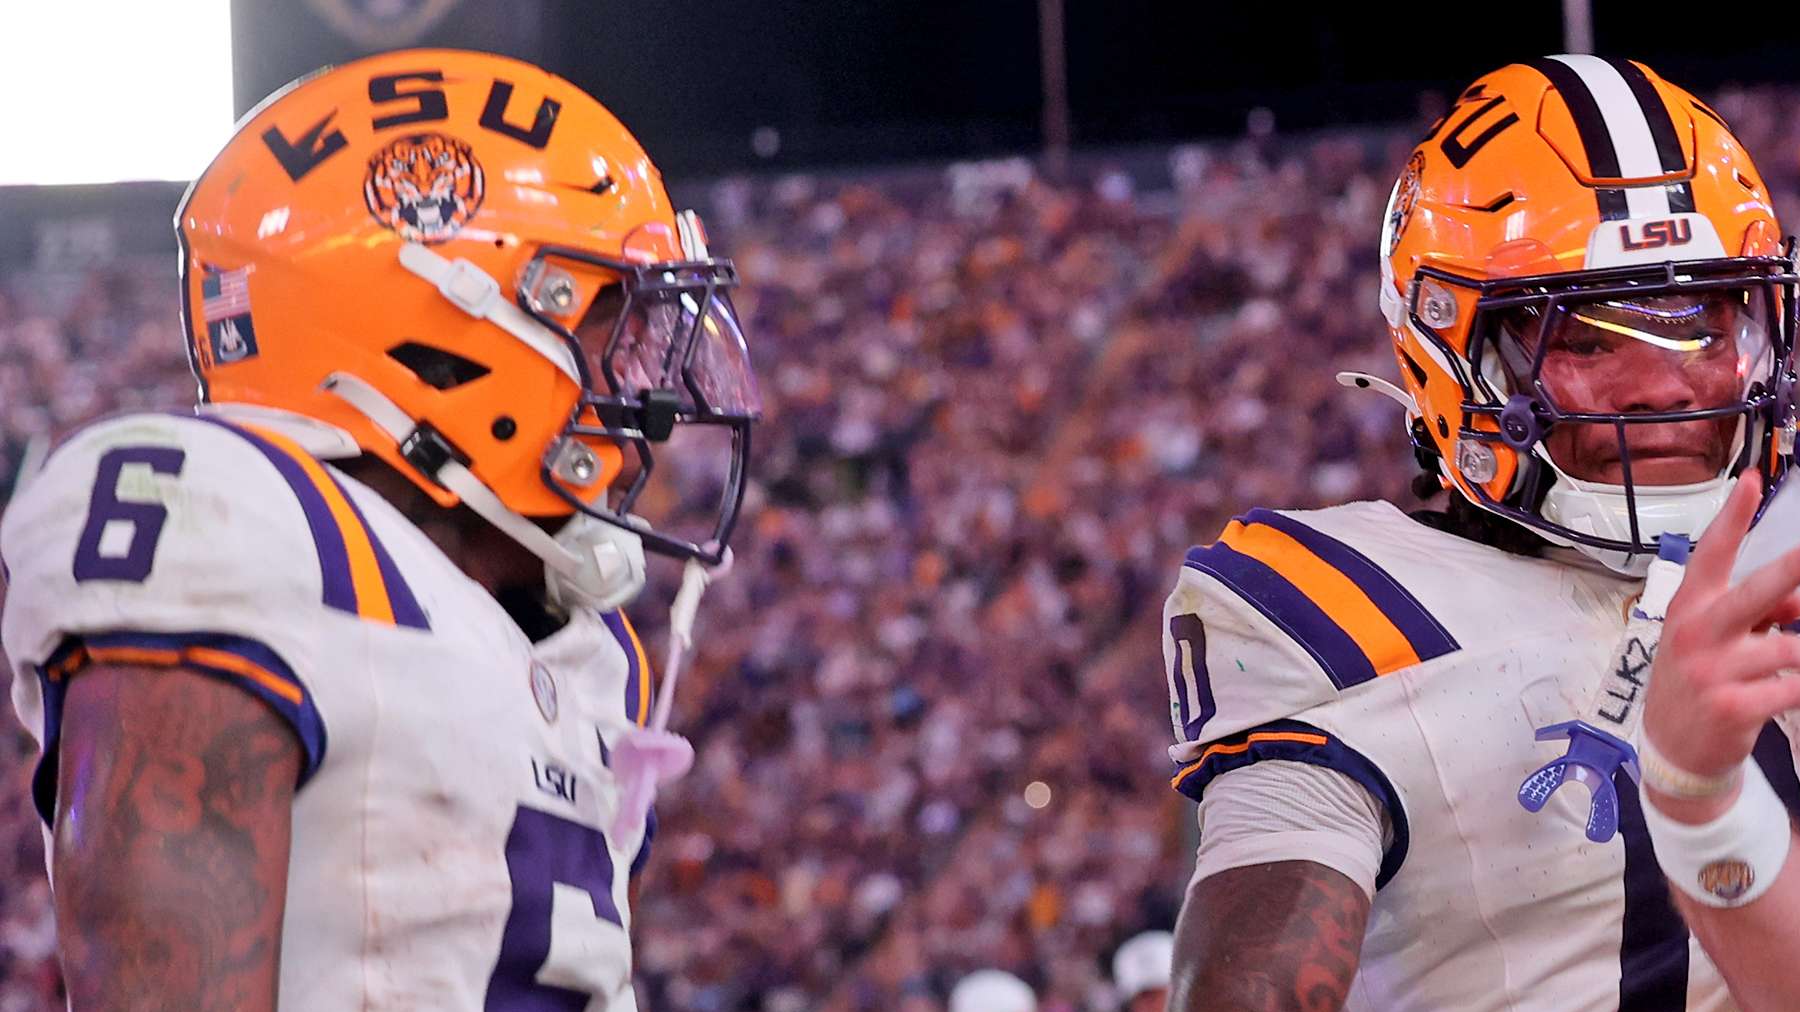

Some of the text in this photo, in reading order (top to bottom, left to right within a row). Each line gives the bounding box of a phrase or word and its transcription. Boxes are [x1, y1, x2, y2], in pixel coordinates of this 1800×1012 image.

[261, 70, 562, 182] LSU
[1620, 218, 1692, 251] LSU
[72, 446, 186, 585] 6
[1170, 612, 1216, 742] 0
